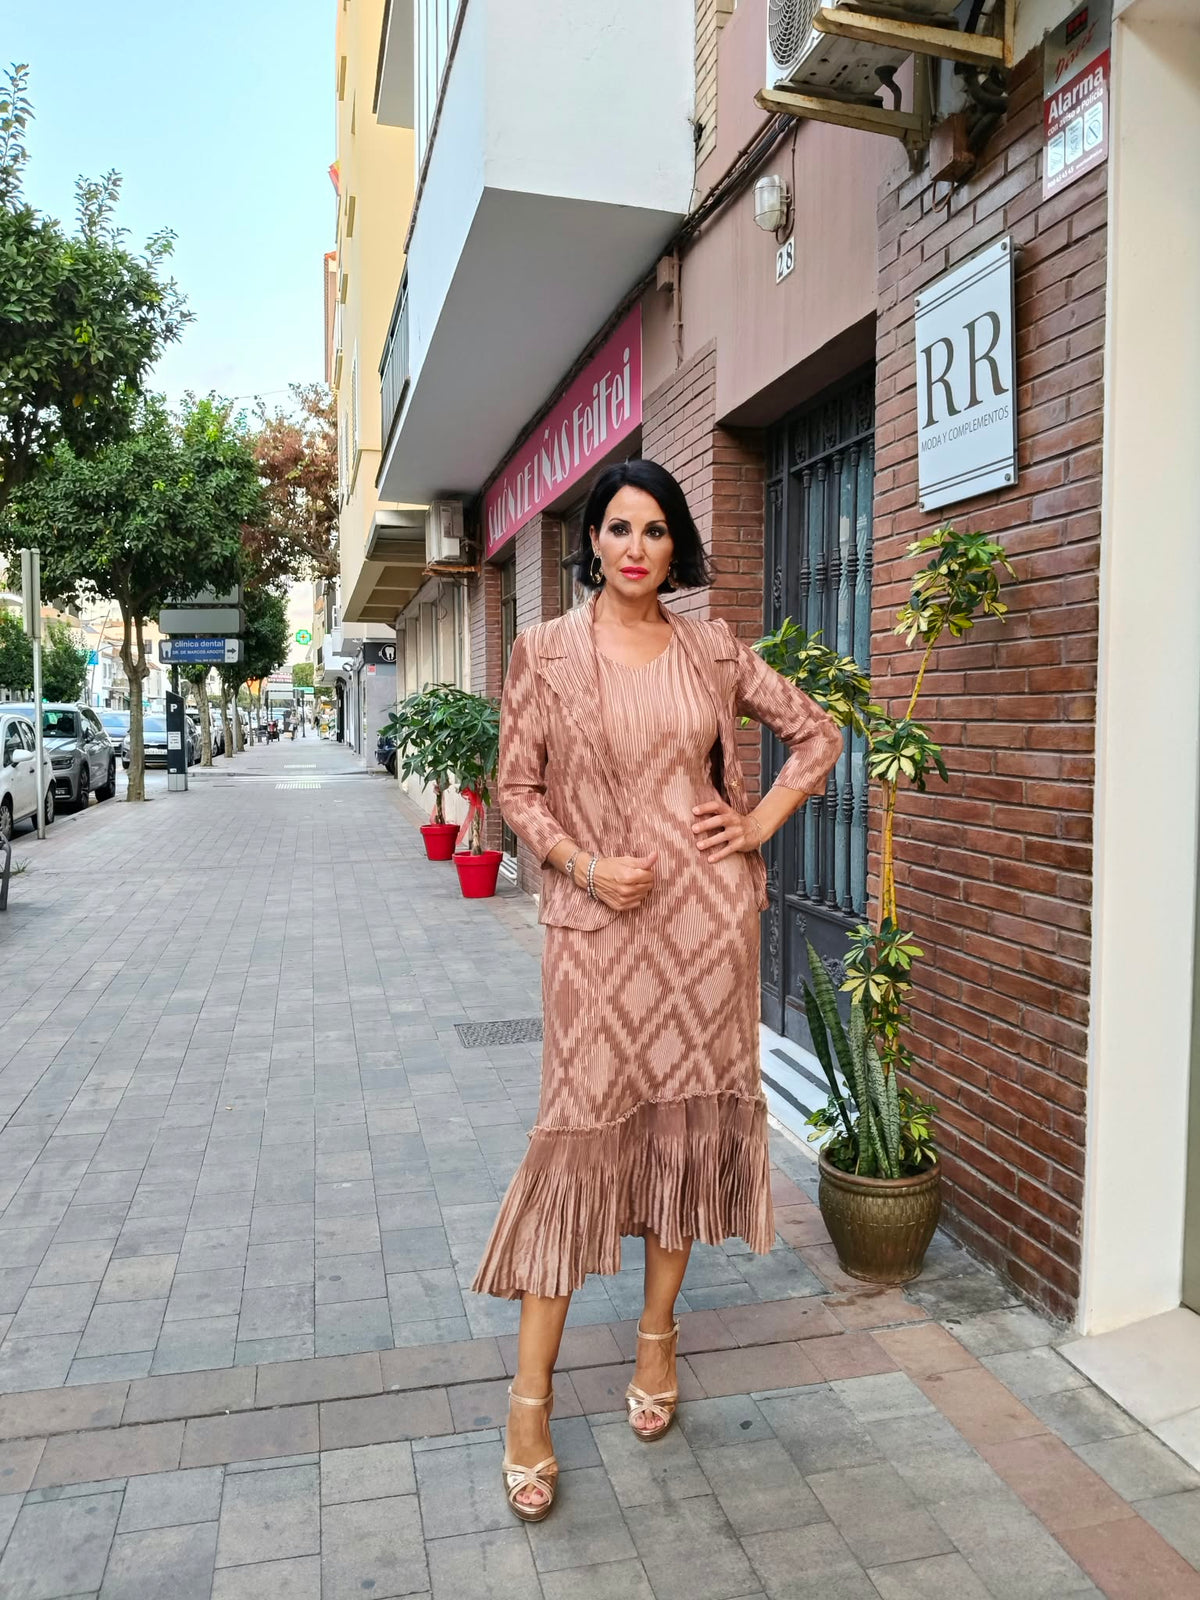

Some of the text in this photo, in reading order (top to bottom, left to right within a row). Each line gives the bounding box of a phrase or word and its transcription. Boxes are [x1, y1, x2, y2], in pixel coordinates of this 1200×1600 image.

[1048, 66, 1104, 124] Alarma
[1047, 122, 1059, 136] con
[1059, 110, 1076, 127] aviso
[778, 243, 792, 278] 28
[920, 311, 1009, 430] RR
[517, 462, 532, 520] DE
[533, 419, 570, 502] UÑAS
[573, 347, 631, 467] FeiFei
[921, 405, 1010, 453] MODA Y COMPLEMENTOS
[200, 639, 224, 647] dental
[170, 704, 177, 712] P
